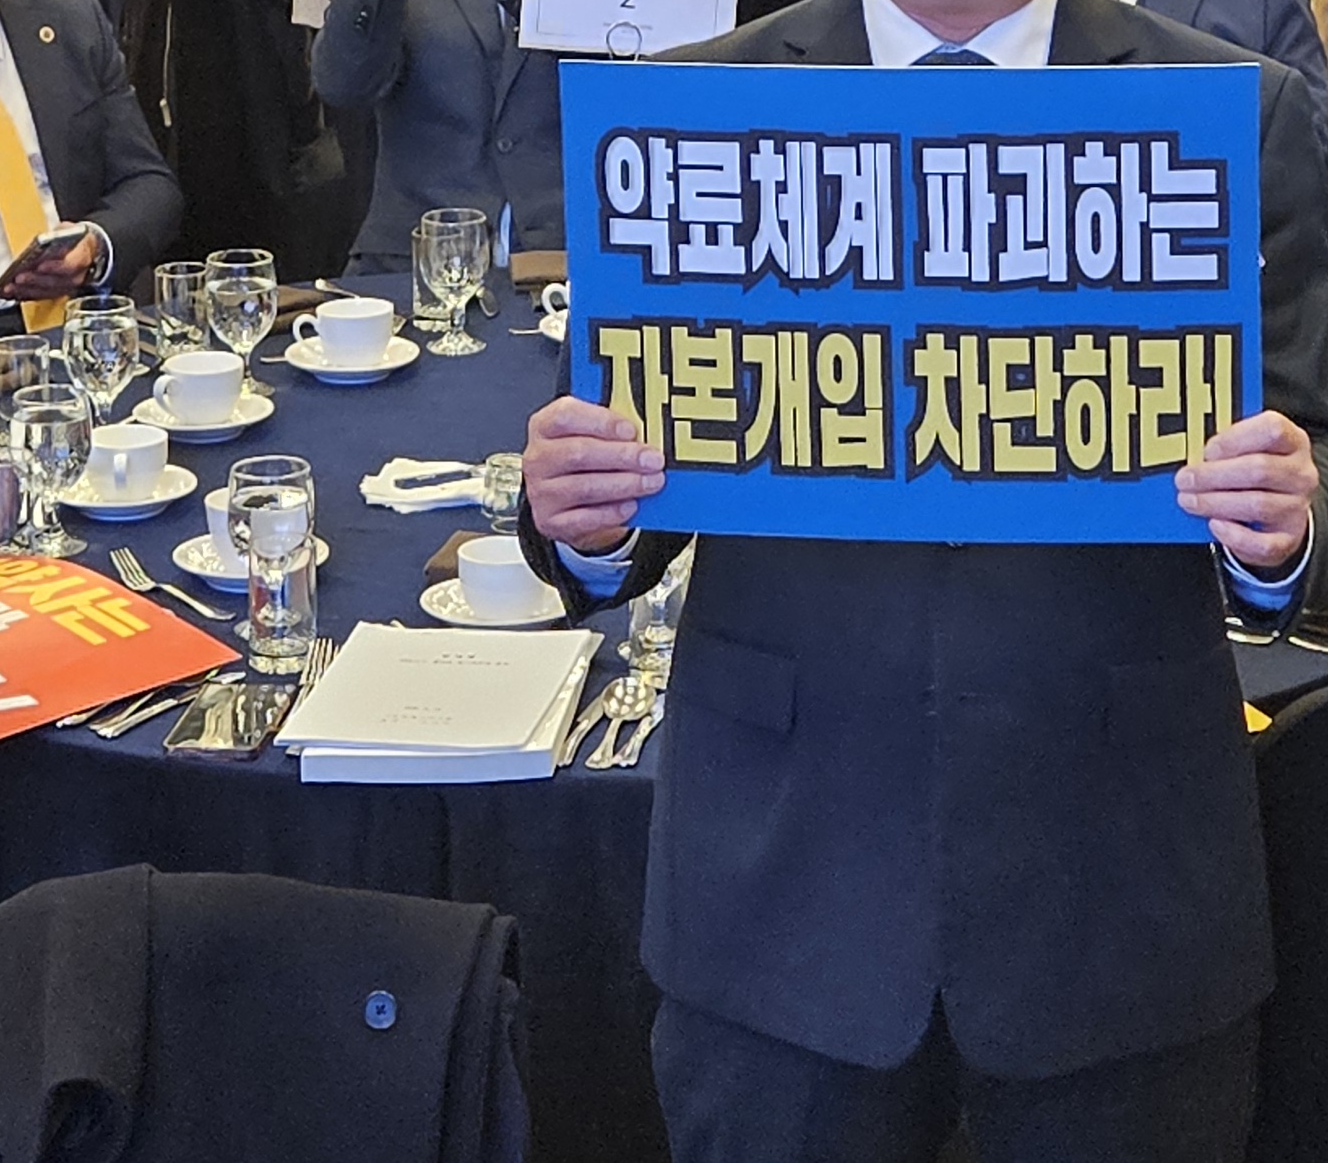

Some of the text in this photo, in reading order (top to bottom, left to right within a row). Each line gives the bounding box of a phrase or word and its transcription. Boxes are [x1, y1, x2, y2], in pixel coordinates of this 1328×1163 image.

[603, 132, 1223, 287] 약료체계 파괴하는
[595, 322, 1235, 477] 자본개입 차단하라!
